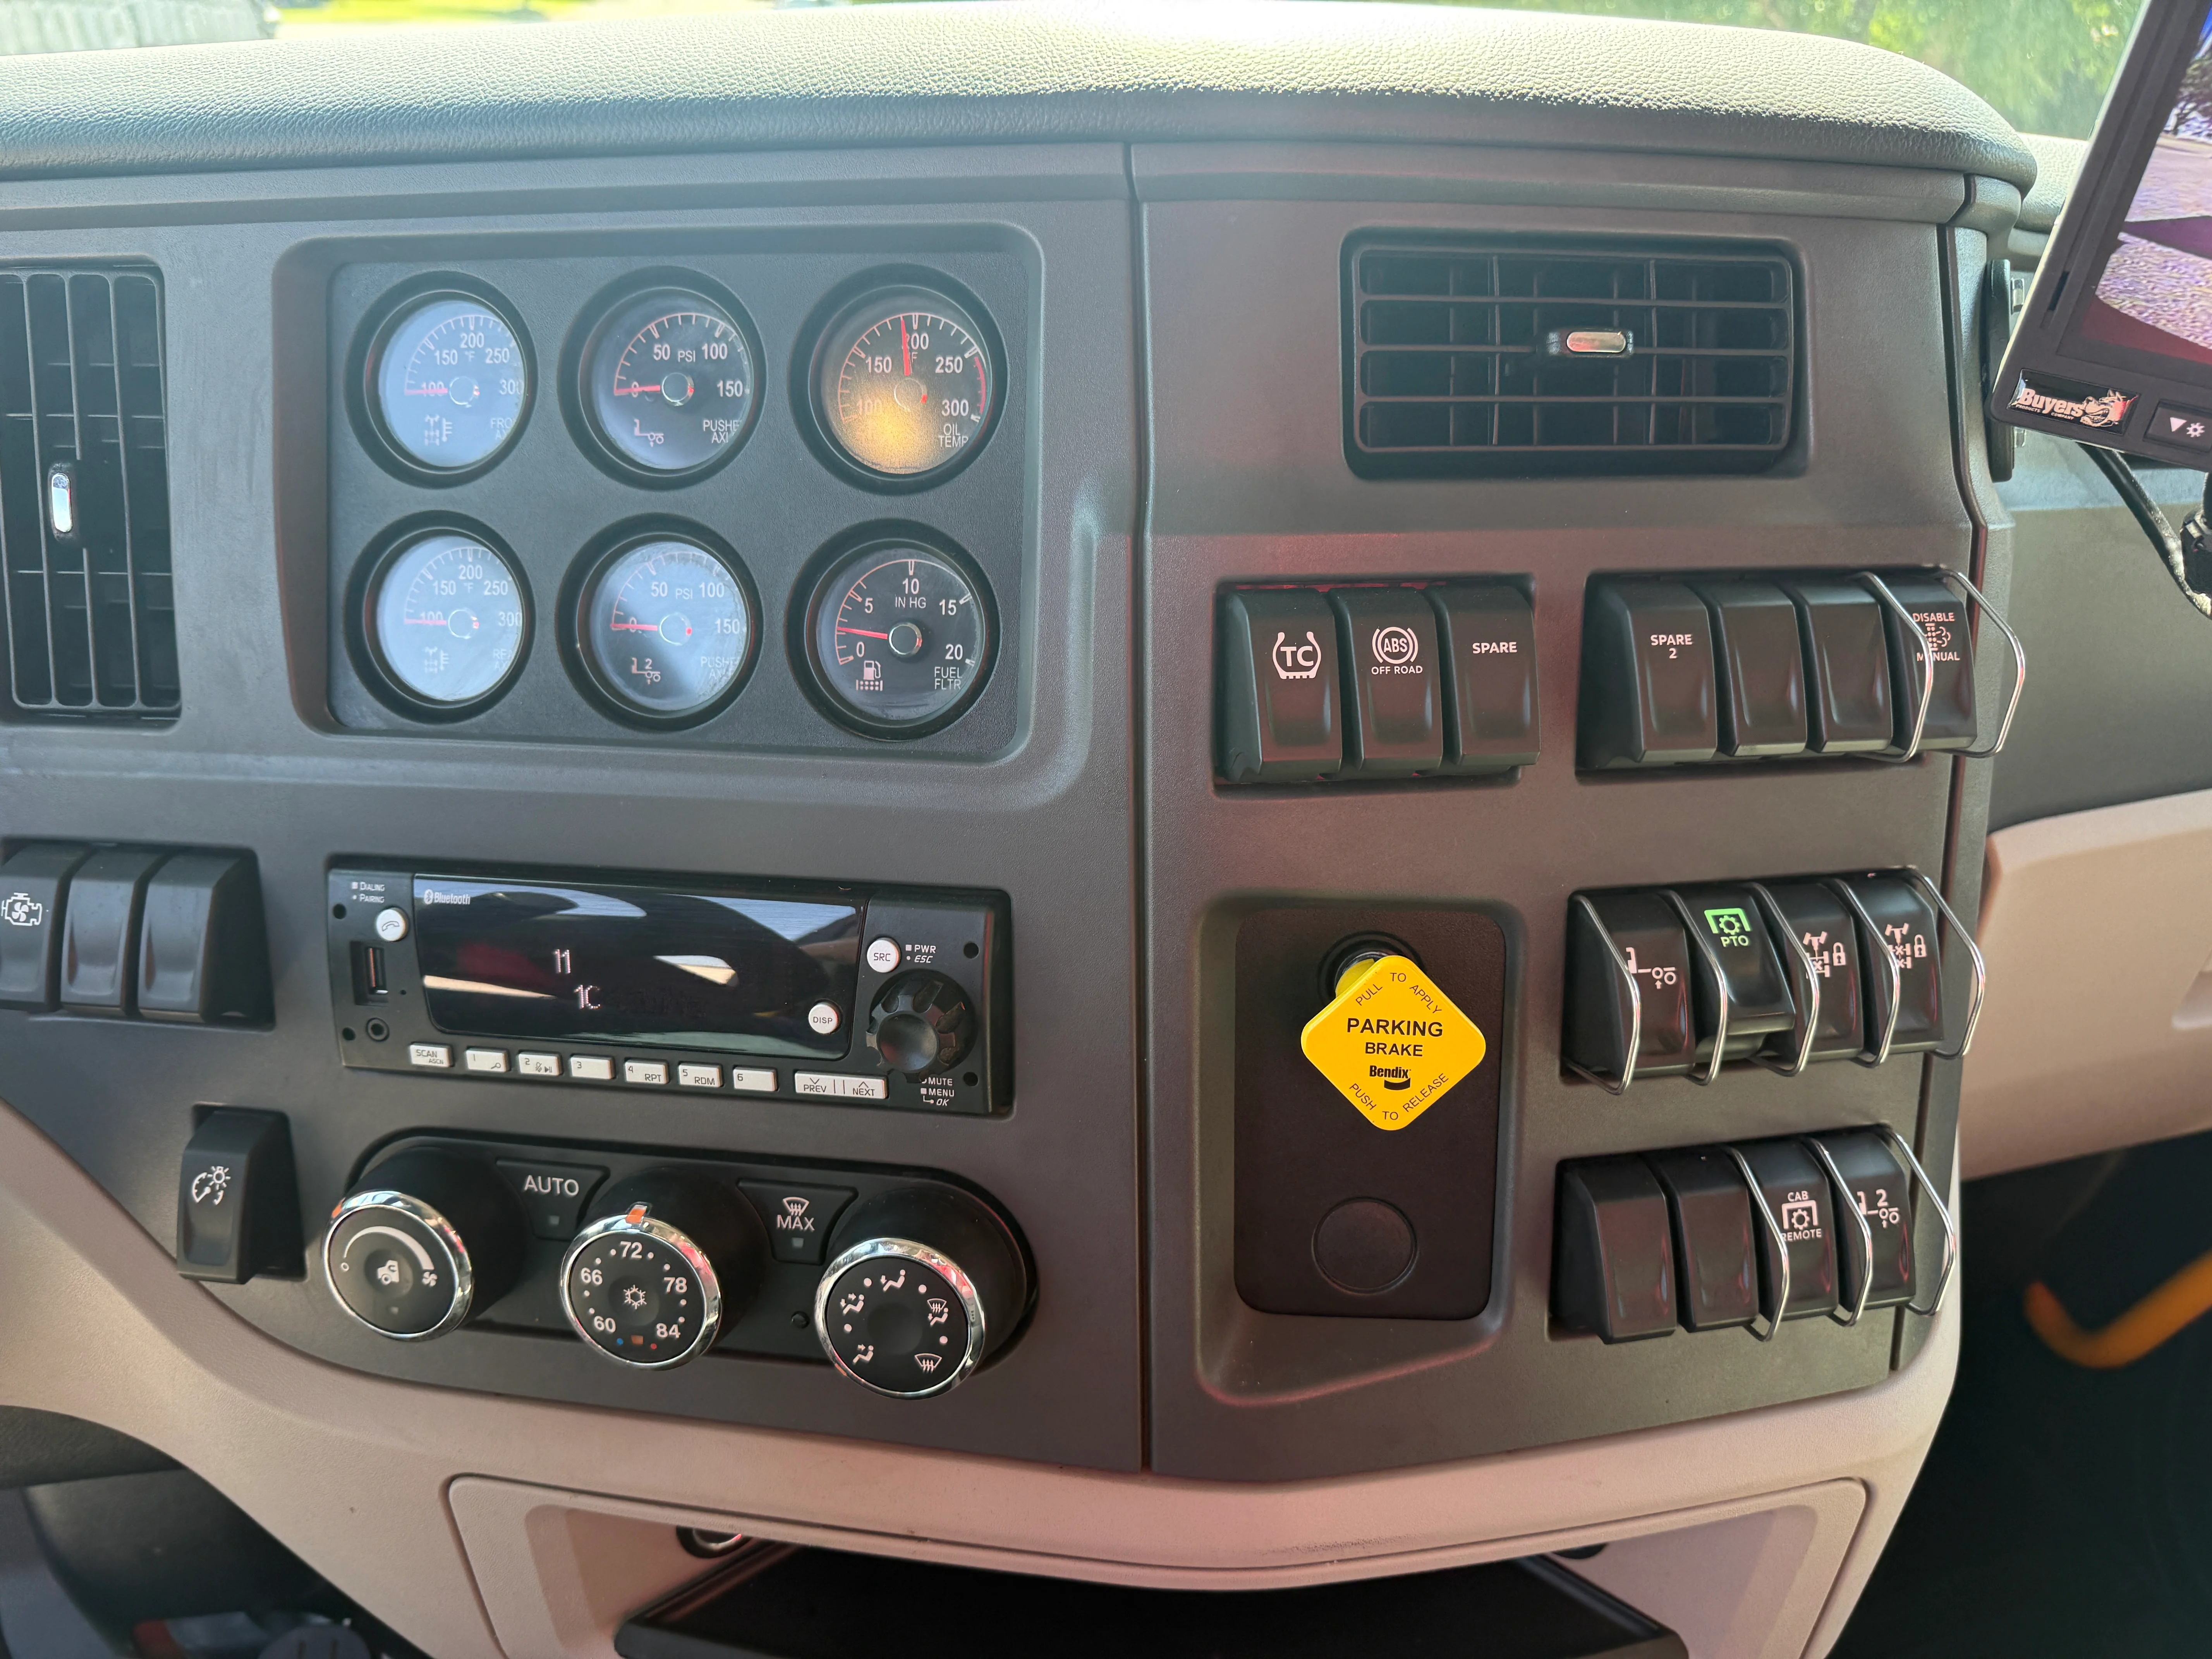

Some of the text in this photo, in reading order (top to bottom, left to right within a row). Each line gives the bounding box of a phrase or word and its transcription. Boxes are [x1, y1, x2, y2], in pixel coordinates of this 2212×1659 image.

[460, 333, 484, 348] 200
[434, 350, 458, 365] 150
[485, 348, 509, 364] 250
[653, 344, 670, 361] 50
[678, 350, 695, 362] PSI
[702, 343, 727, 360] 100
[866, 357, 891, 373] 150
[935, 357, 962, 373] 250
[422, 381, 444, 396] 100
[717, 381, 743, 397] 150
[941, 400, 969, 416] 300
[2015, 404, 2041, 413] PRODUCTS
[2017, 388, 2083, 417] Buyers
[491, 418, 516, 429] FRO
[944, 422, 960, 435] OIL
[938, 435, 968, 447] TEMP
[459, 565, 483, 579] 200
[433, 581, 456, 595] 150
[484, 581, 508, 596] 250
[651, 582, 668, 597] 50
[699, 582, 724, 598] 100
[903, 579, 919, 594] 10
[676, 589, 692, 599] PSI
[865, 598, 873, 613] 5
[895, 597, 926, 608] IN HG
[939, 599, 957, 615] 15
[1912, 612, 1955, 622] DISABLE
[715, 618, 740, 634] 150
[1383, 638, 1407, 652] ABS
[1650, 634, 1693, 646] SPARE
[856, 642, 864, 657] 0
[945, 644, 963, 660] 20
[1472, 642, 1517, 654] SPARE
[1669, 648, 1677, 659] 2
[1280, 646, 1314, 666] TC
[1917, 652, 1960, 661] MNUAL
[646, 658, 652, 669] 2
[1371, 666, 1422, 675] OFF ROAD
[934, 667, 962, 678] FUEL
[935, 678, 961, 690] FLTR
[434, 892, 471, 905] Bluetooth
[1720, 935, 1748, 947] PTO
[915, 945, 936, 953] PWR
[874, 953, 891, 962] SRC
[914, 955, 933, 964] ESC
[1355, 972, 1442, 1014] PULL TO APPLY
[813, 1016, 833, 1024] DISP
[1346, 1018, 1443, 1037] PARKING
[416, 1049, 437, 1058] SCAN
[1365, 1042, 1423, 1057] BRAKE
[645, 1074, 661, 1083] RPT
[1369, 1065, 1412, 1079] Bendix
[694, 1076, 715, 1085] RDM
[928, 1077, 953, 1086] MUTE
[804, 1084, 826, 1093] PREV
[853, 1087, 875, 1097] NEXT
[929, 1089, 955, 1097] MENU
[936, 1098, 949, 1106] OK
[1349, 1073, 1449, 1120] PUSH TO RELEASE
[524, 1175, 579, 1196] AUTO
[1788, 1191, 1808, 1201] CAB
[1876, 1189, 1889, 1207] 2
[776, 1215, 815, 1231] MAX
[1781, 1228, 1821, 1242] REMOTE
[620, 1242, 642, 1259] 72
[581, 1267, 603, 1285] 66
[663, 1278, 687, 1293] 78
[594, 1316, 616, 1333] 60
[656, 1324, 681, 1338] 84
